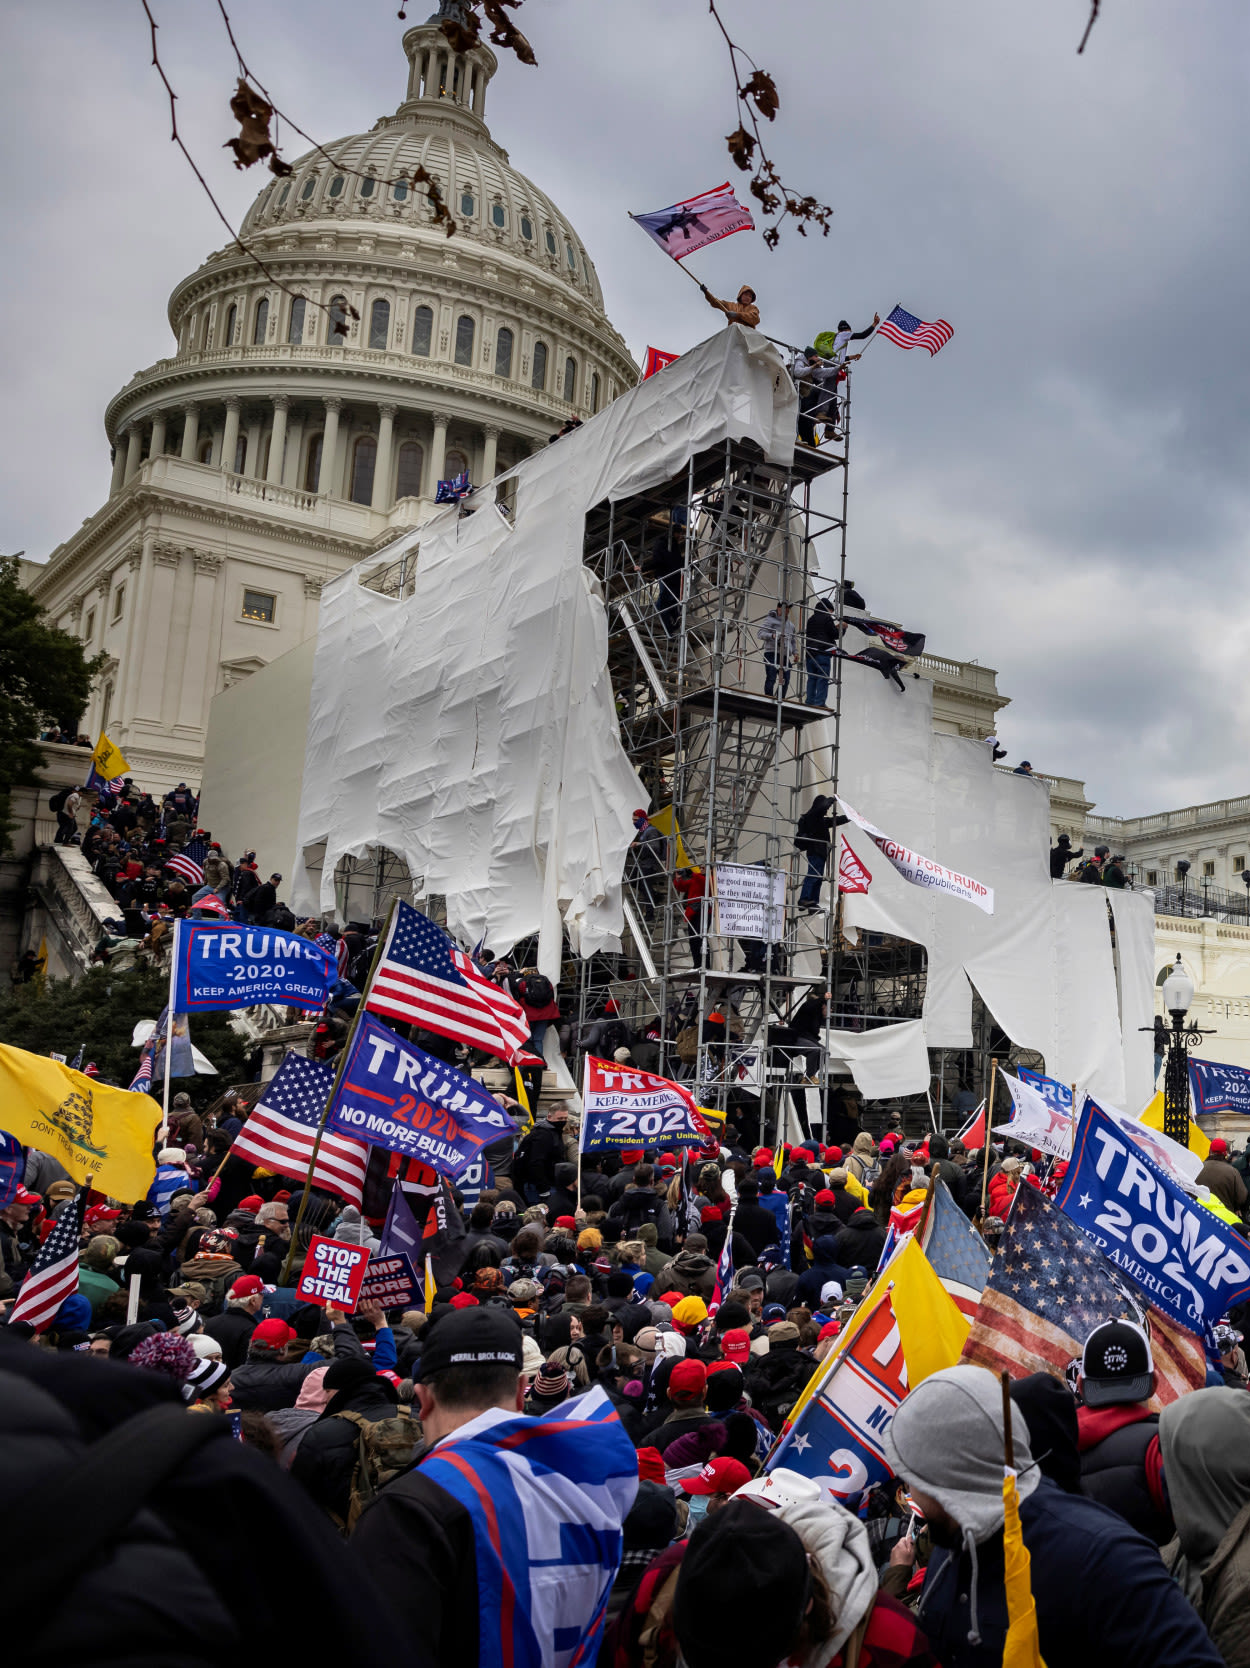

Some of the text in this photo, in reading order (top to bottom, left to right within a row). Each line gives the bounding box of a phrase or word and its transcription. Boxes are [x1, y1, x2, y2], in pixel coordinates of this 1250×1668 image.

[706, 232, 720, 241] AND
[721, 223, 737, 235] TAKE
[915, 869, 972, 898] Republicans
[917, 855, 943, 876] FOR
[944, 870, 988, 896] TRUMP
[727, 889, 739, 898] they
[194, 982, 323, 998] KEEP AMERICA GREAT!
[367, 1034, 510, 1128] TRUMP
[595, 1095, 628, 1107] KEEP
[1205, 1095, 1224, 1104] KEEP
[339, 1104, 366, 1126] NO
[366, 1114, 419, 1145] MORE
[391, 1093, 458, 1142] 2020
[30, 1120, 56, 1137] DONT
[75, 1155, 89, 1166] ON
[89, 1159, 104, 1172] ME
[605, 1136, 645, 1144] President
[660, 1133, 672, 1141] The
[314, 1243, 362, 1268] STOP
[317, 1261, 351, 1285] THE
[1107, 1248, 1183, 1311] AMERICA
[301, 1277, 354, 1305] STEAL
[378, 1293, 411, 1308] ARS
[450, 1352, 477, 1362] MERRILL
[1108, 1355, 1123, 1363] 1776
